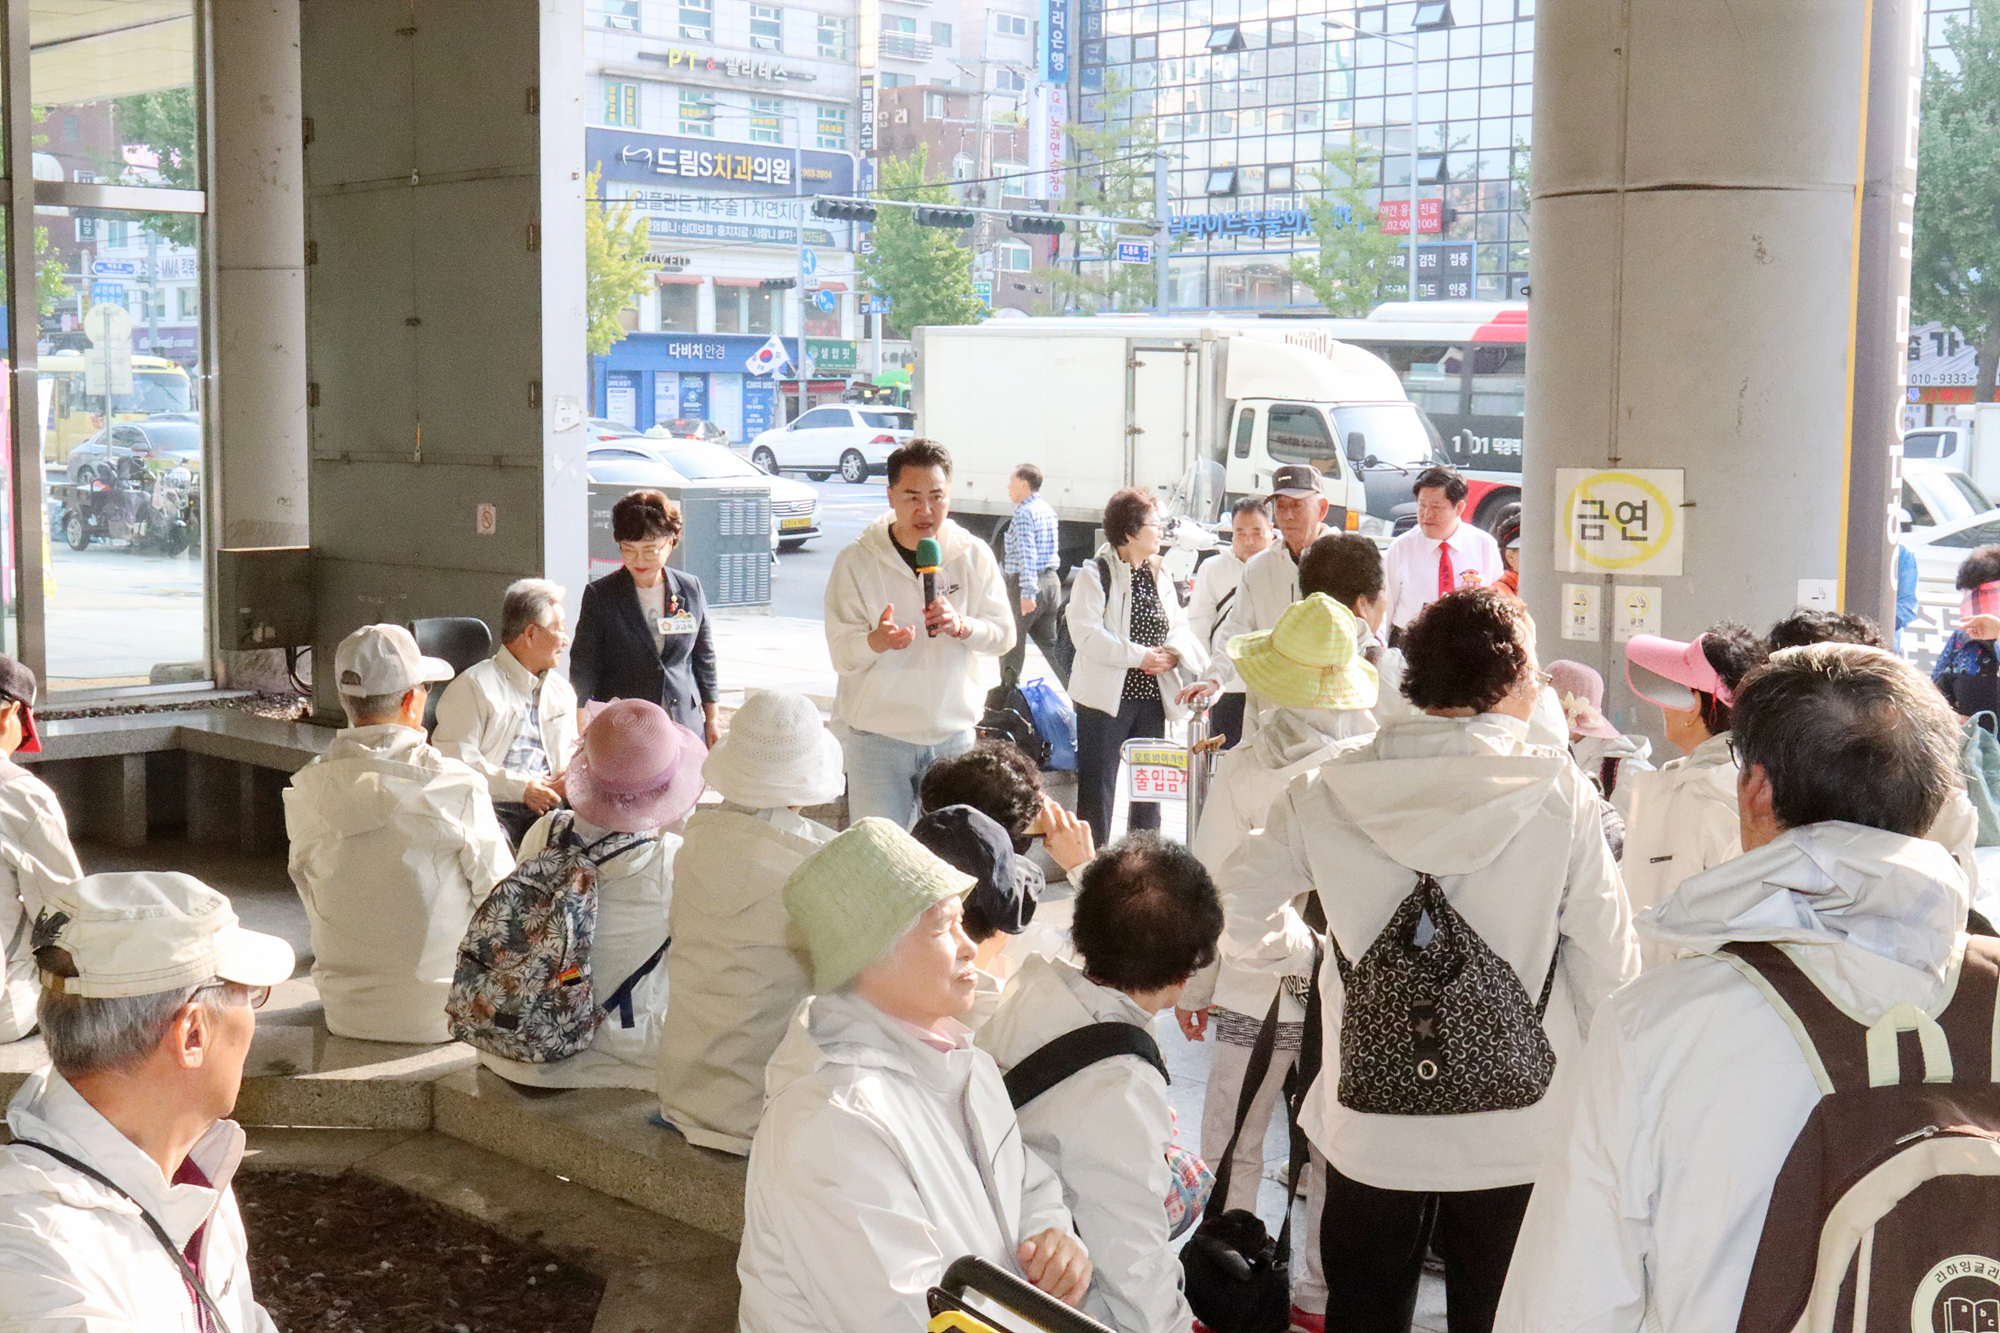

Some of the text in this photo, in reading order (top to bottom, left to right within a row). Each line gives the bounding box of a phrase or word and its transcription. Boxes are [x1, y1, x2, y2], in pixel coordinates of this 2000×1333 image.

[668, 48, 788, 81] PT & 필라테스
[862, 88, 873, 136] 필라테스
[657, 147, 791, 185] 드림S치과의원
[634, 189, 692, 213] 임플란트
[697, 196, 738, 217] 재수술
[1420, 202, 1438, 215] 진료
[681, 222, 713, 236] 심미보철
[717, 226, 749, 238] 충치치료
[752, 228, 776, 239] 사랑니
[1419, 253, 1437, 267] 검진
[1449, 252, 1469, 266] 접종
[1448, 282, 1468, 297] 인증
[1911, 373, 1978, 385] 010-9333-
[1577, 499, 1648, 541] 금연
[1134, 752, 1169, 764] 오토바이
[1934, 1261, 2000, 1284] 라하잉글리
[1961, 1304, 1995, 1327] a b c
